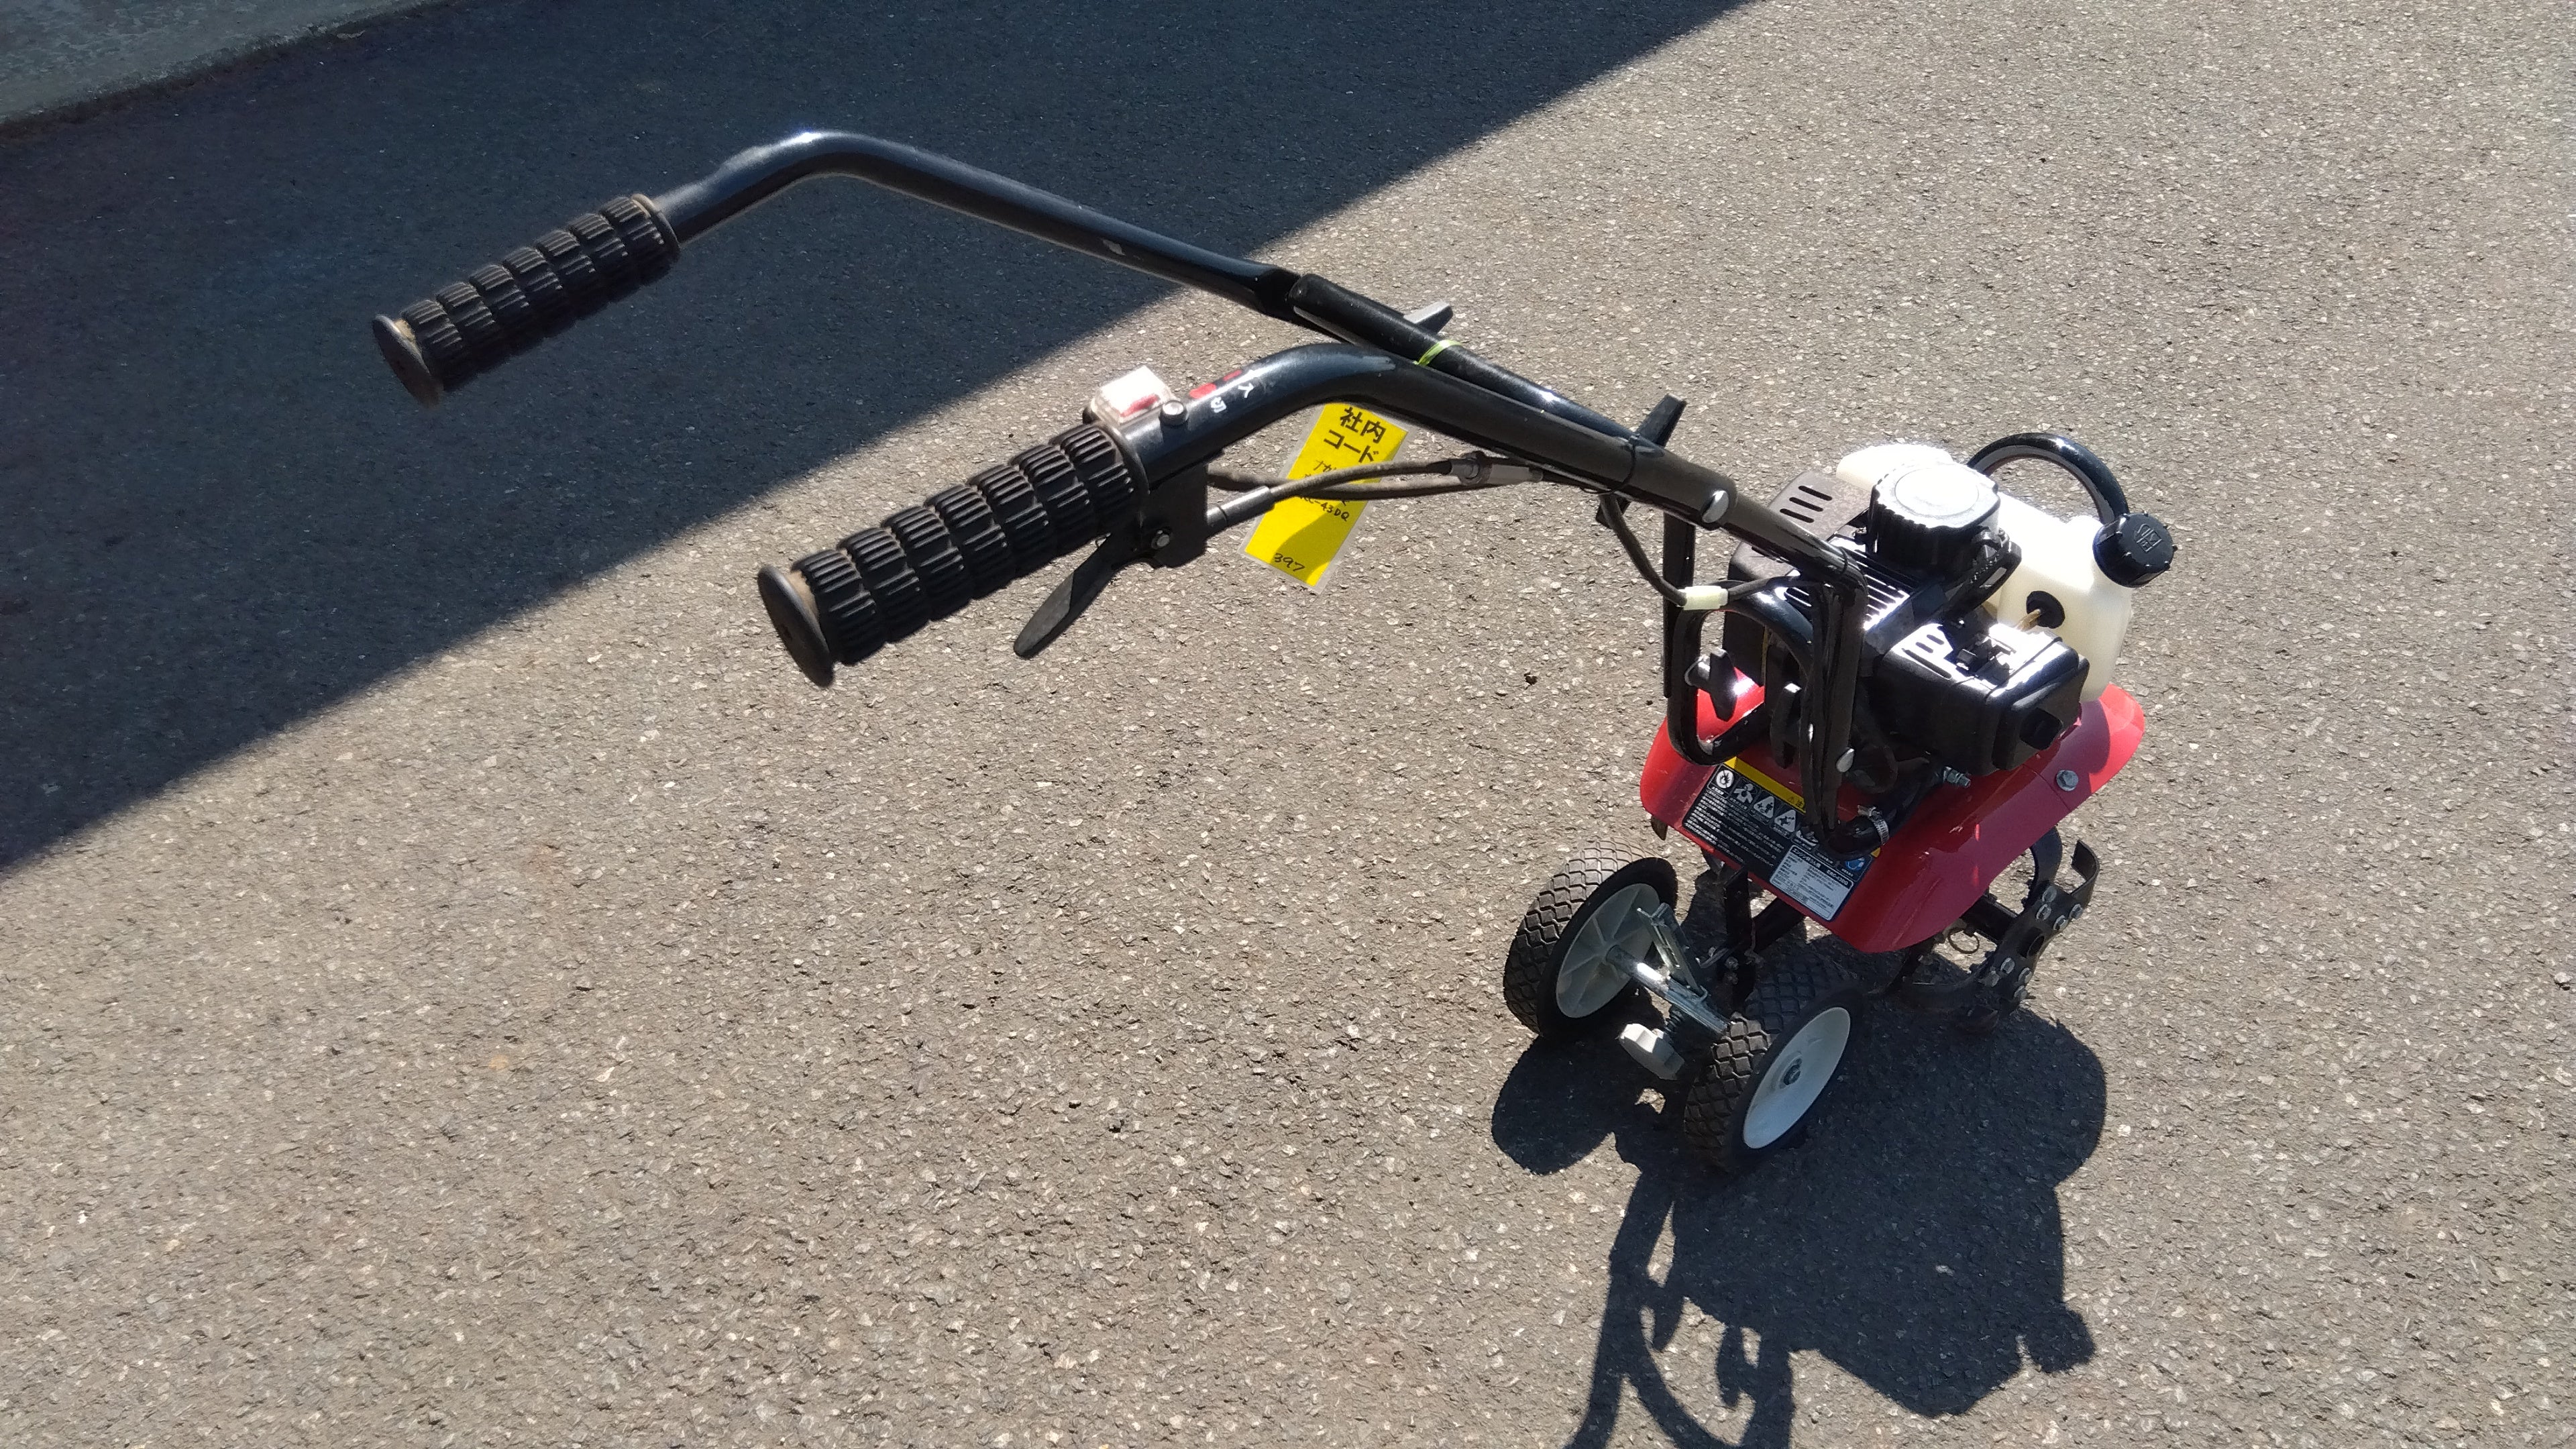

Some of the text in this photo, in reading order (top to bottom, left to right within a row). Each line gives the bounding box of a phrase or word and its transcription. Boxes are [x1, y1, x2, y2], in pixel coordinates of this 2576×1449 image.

[1340, 407, 1387, 444] 社内
[1324, 429, 1379, 463] コード
[1274, 553, 1305, 572] 397
